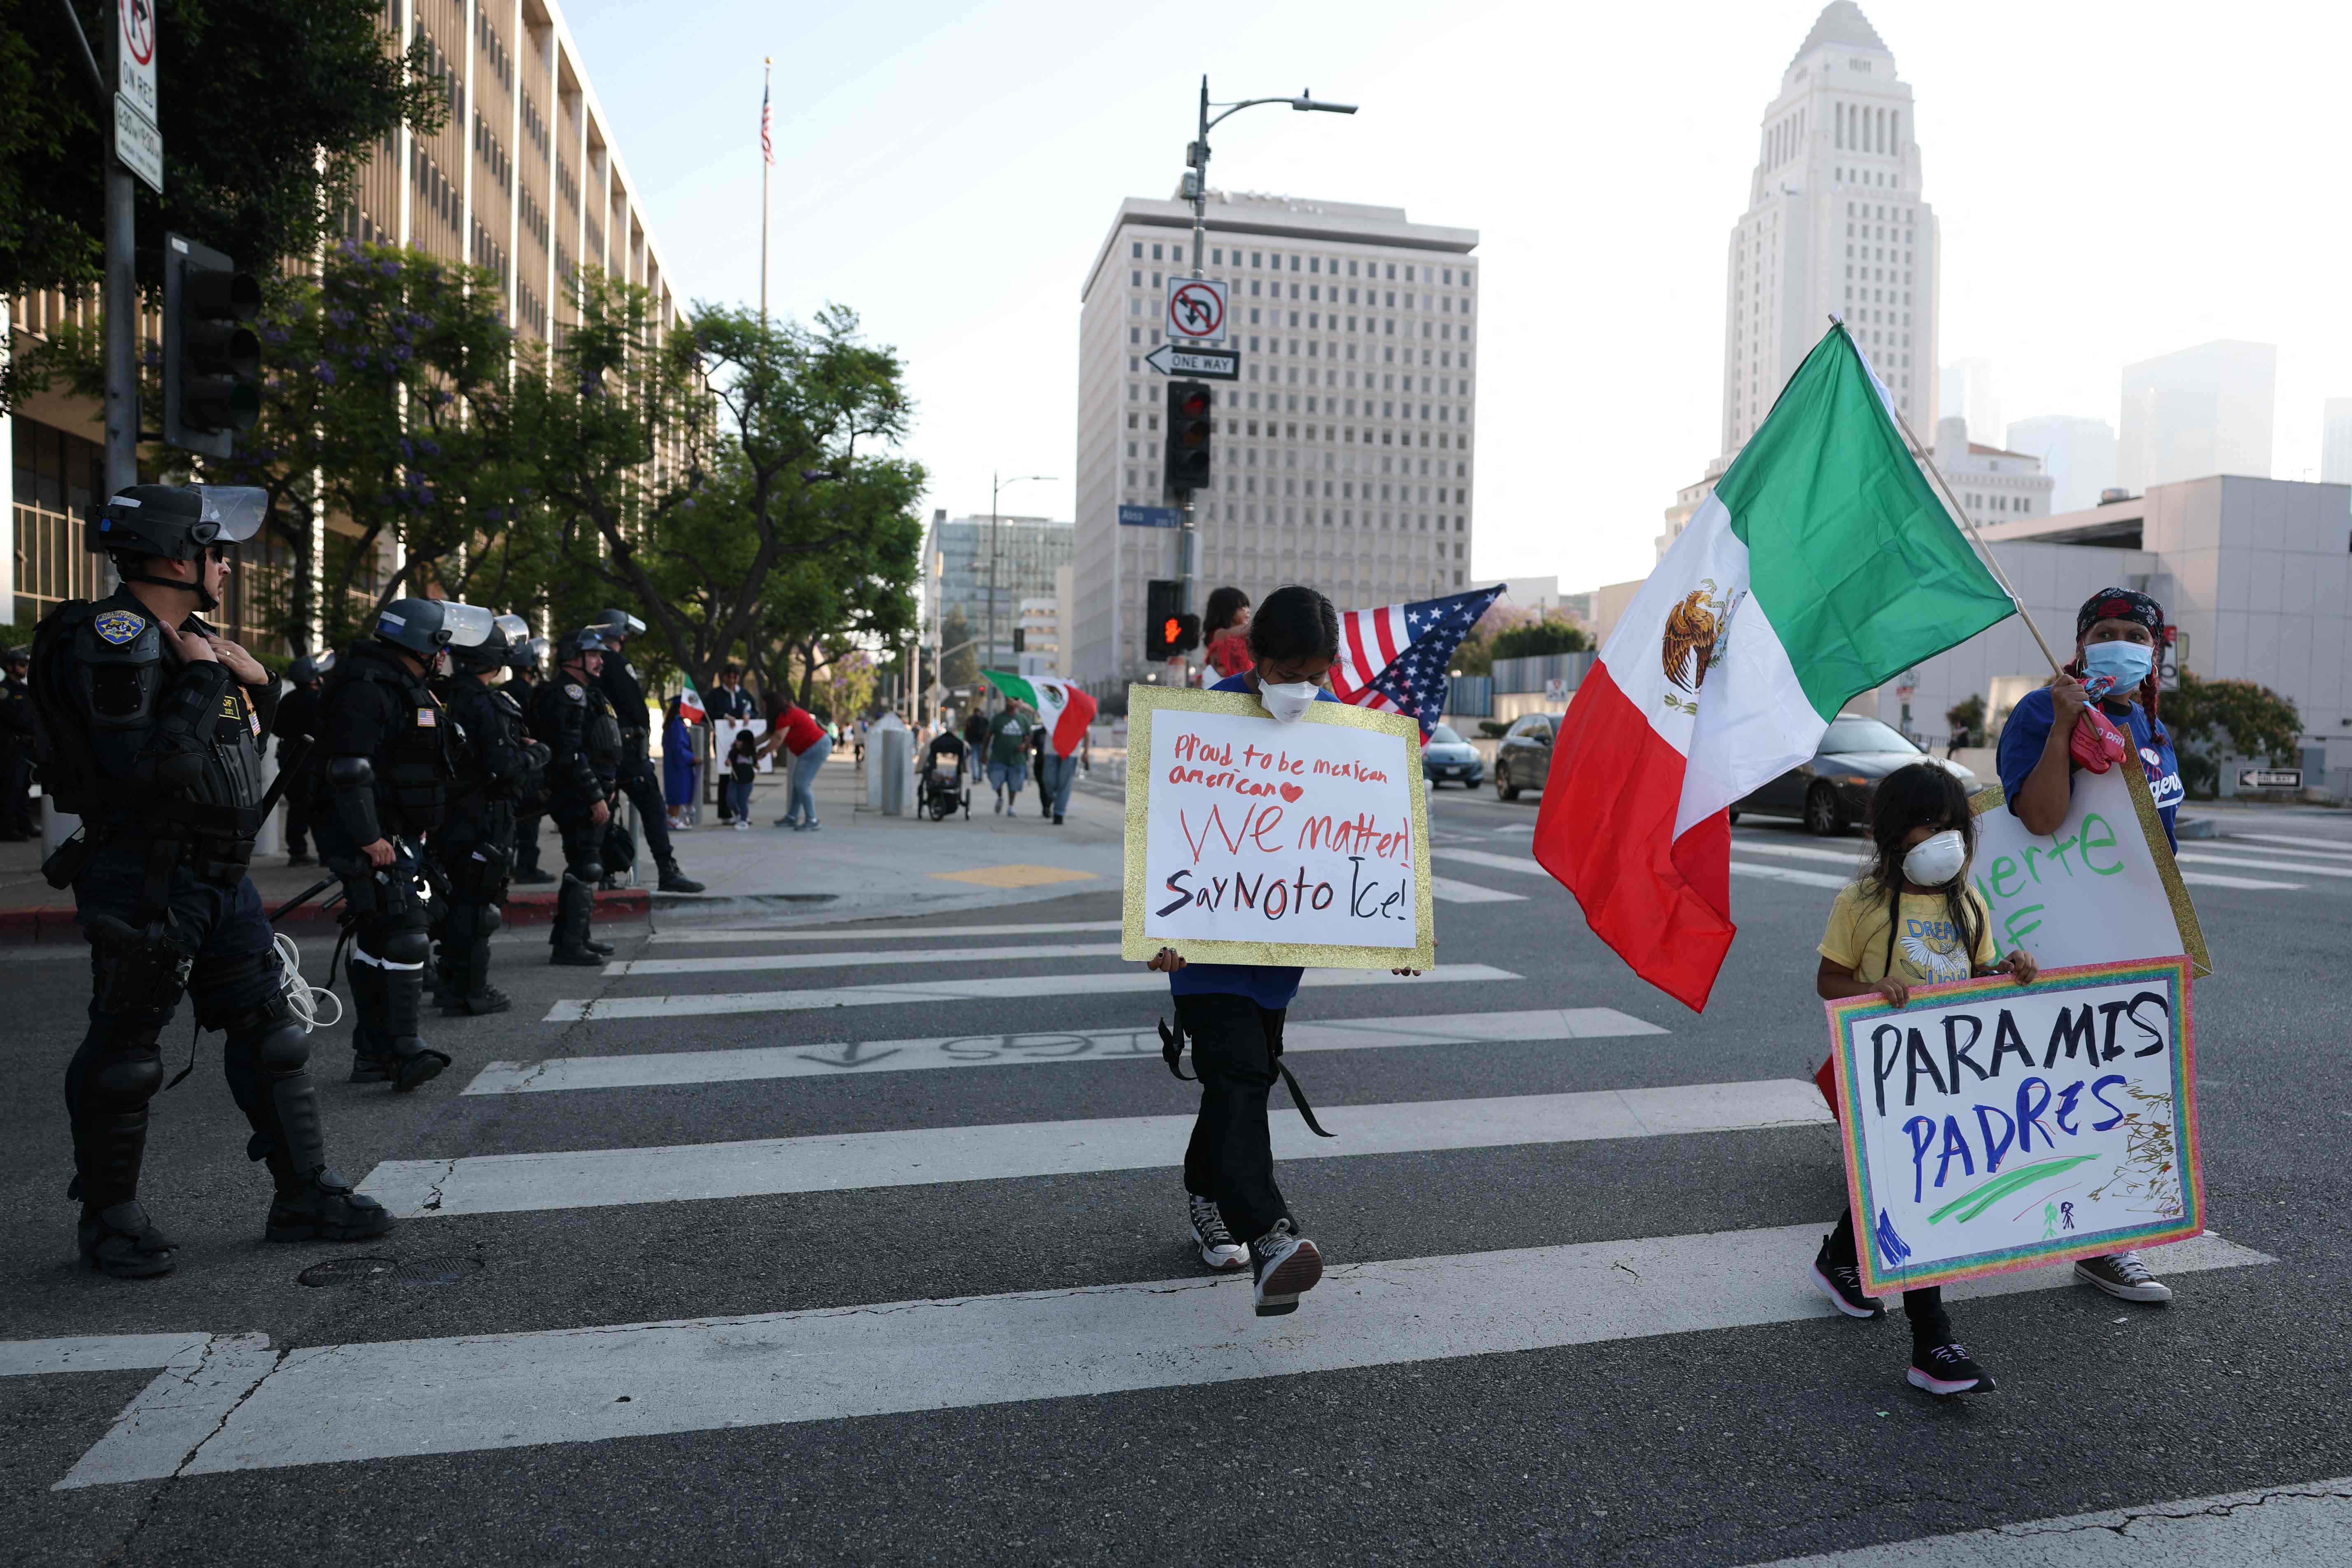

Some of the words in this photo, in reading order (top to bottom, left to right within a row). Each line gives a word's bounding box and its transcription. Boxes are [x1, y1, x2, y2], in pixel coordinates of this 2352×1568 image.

[123, 61, 135, 91] ON
[138, 74, 153, 108] RED
[1172, 355, 1198, 368] ONE
[1203, 358, 1229, 370] WAY
[1169, 765, 1276, 797] american
[1243, 744, 1272, 770] to
[1278, 751, 1305, 775] be
[1313, 758, 1388, 784] mexican
[2145, 771, 2182, 803] gers
[1180, 803, 1283, 865] We
[1348, 856, 1406, 921] Ice!
[1871, 1008, 2036, 1117] PARA
[2043, 991, 2169, 1069] MIS
[1902, 1074, 2128, 1203] PADRES
